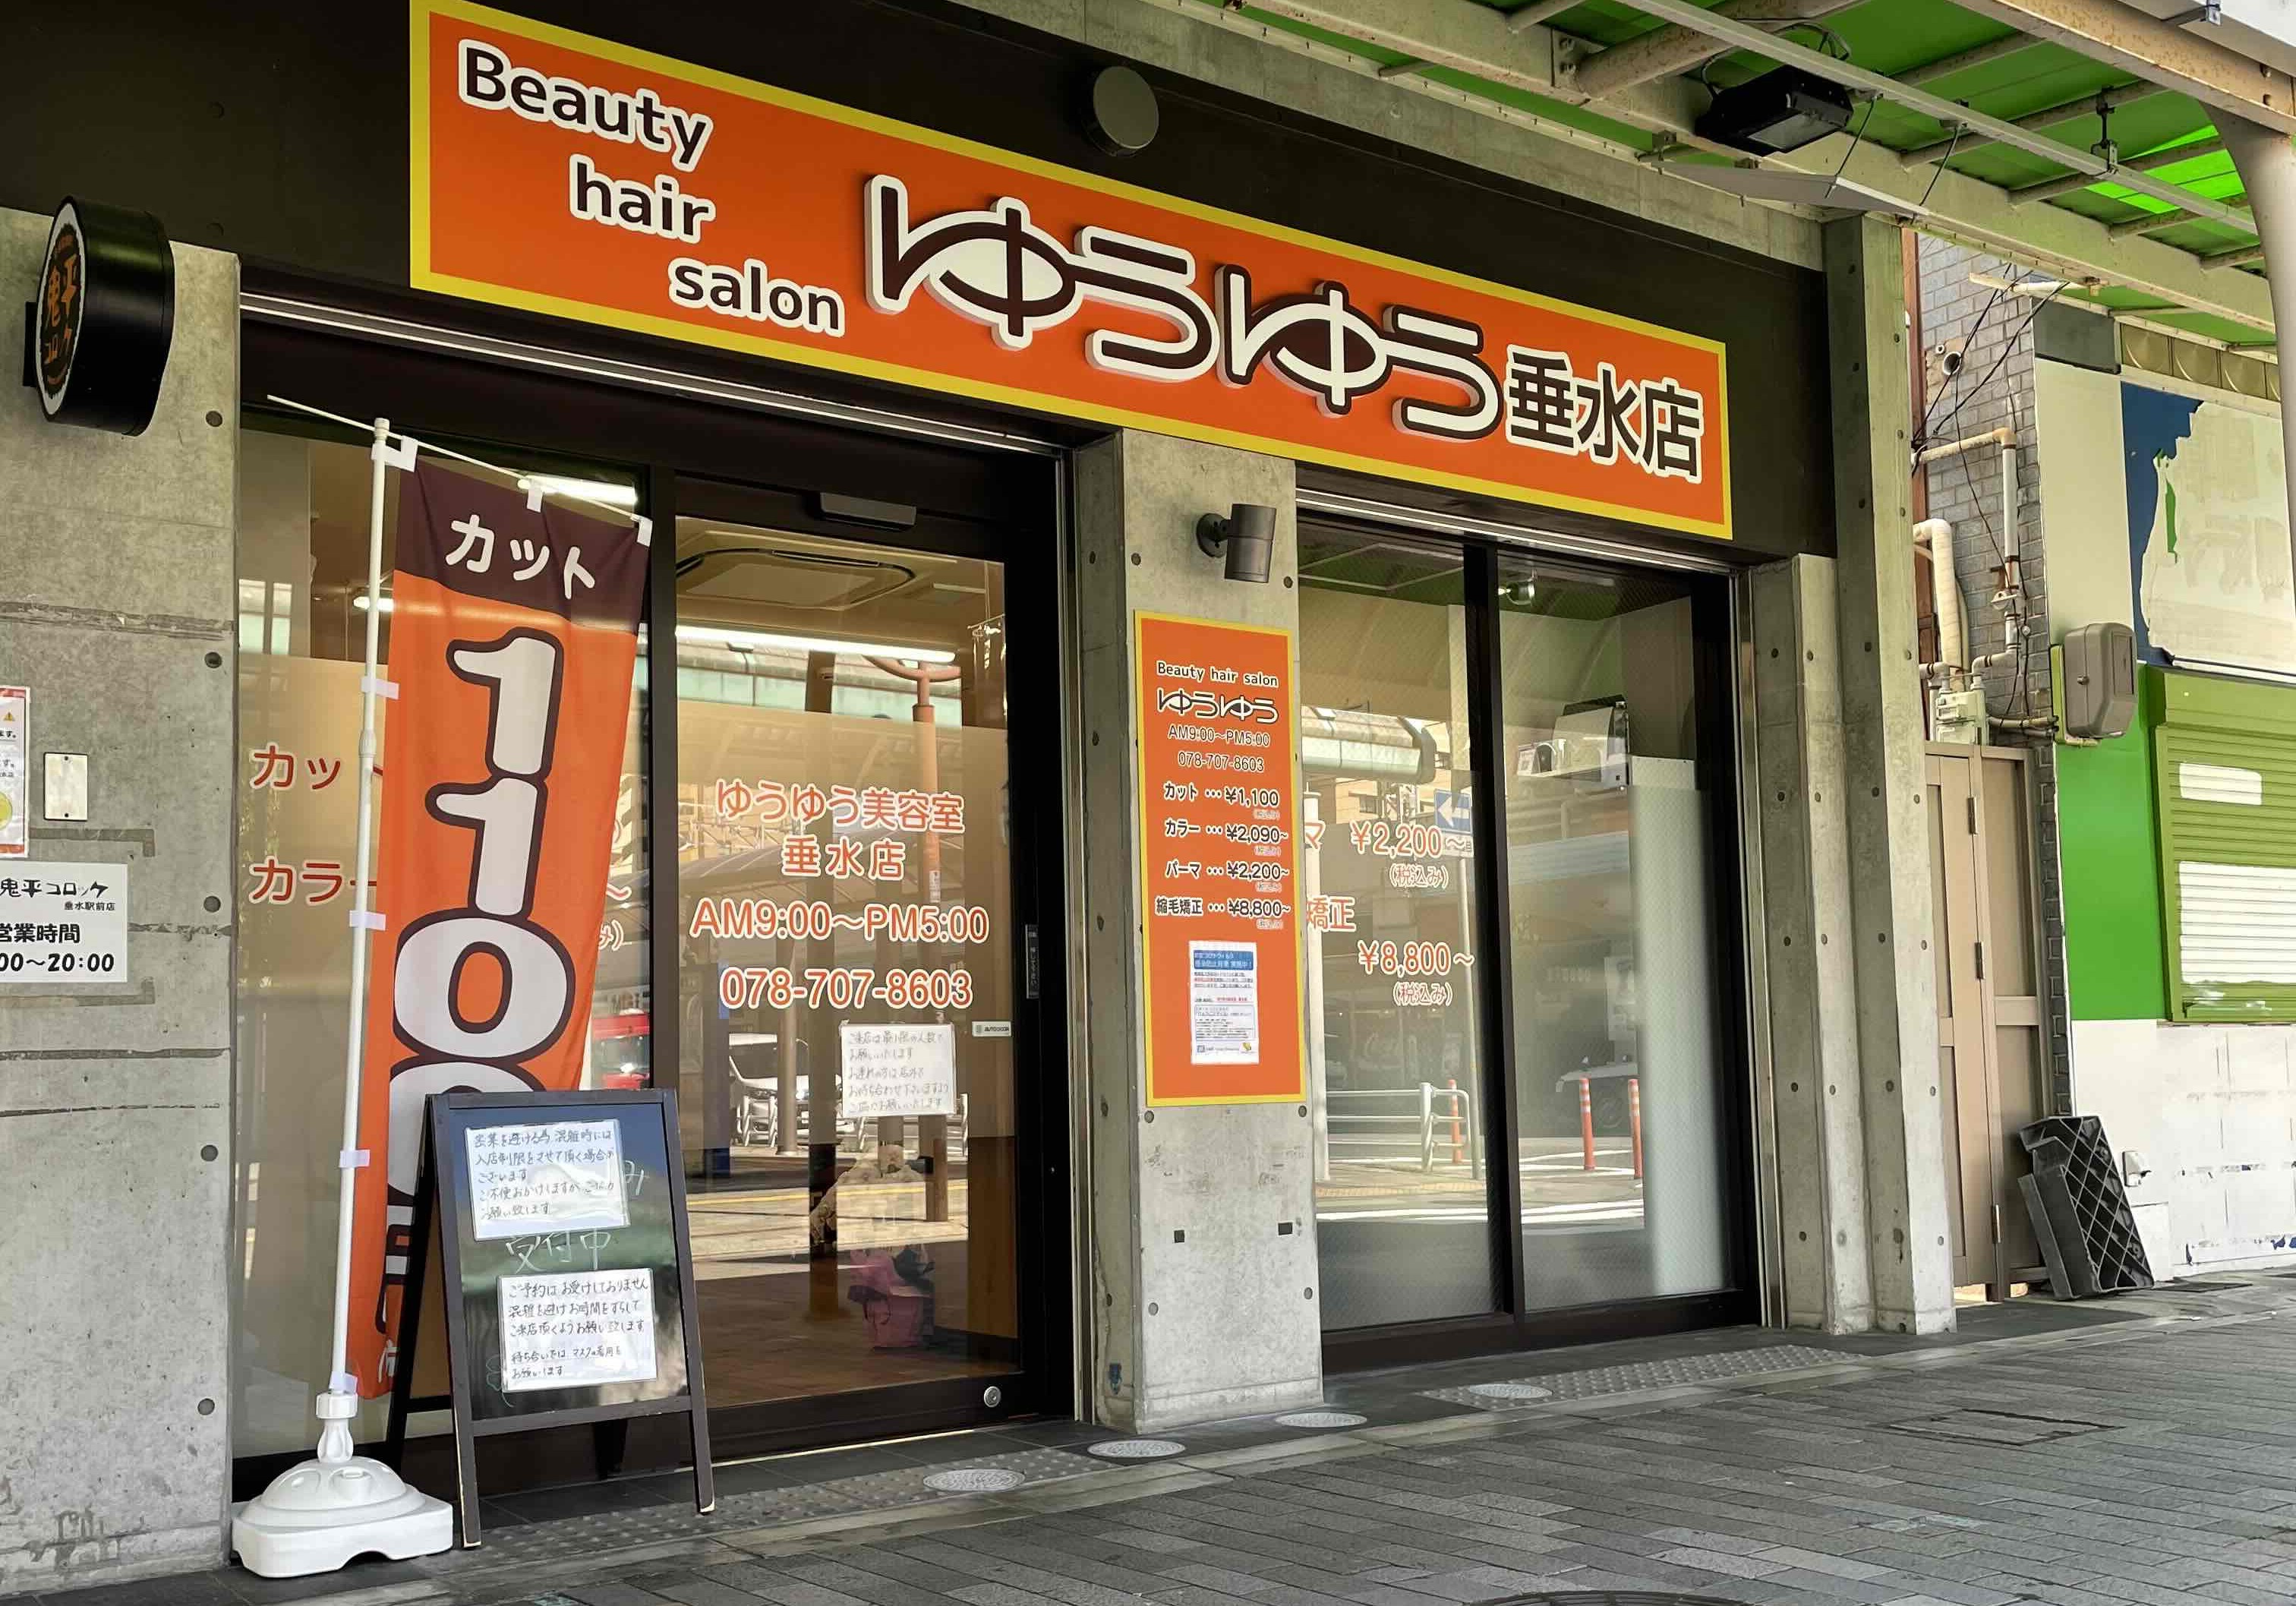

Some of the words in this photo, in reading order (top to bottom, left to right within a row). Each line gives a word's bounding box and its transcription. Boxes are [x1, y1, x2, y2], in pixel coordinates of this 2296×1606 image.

[459, 39, 714, 171] Beauty
[569, 153, 716, 243] hair
[668, 257, 845, 337] salon
[864, 175, 1502, 442] ゆうゆう
[1504, 343, 1705, 484] 垂水店
[445, 514, 595, 600] カット
[1156, 661, 1205, 683] Beauty
[1210, 666, 1238, 683] hair
[1244, 672, 1279, 687] salon
[1156, 688, 1279, 724] ゆうゆう
[249, 741, 383, 791] カッ
[1178, 750, 1265, 773] 078-707-8603
[717, 778, 966, 834] ゆうゆう美容室
[1164, 781, 1198, 801] カット
[1225, 787, 1279, 807] ¥1,100
[1165, 819, 1200, 838] カラー
[781, 834, 906, 881] 垂水店
[1165, 860, 1201, 879] パーマ
[0, 878, 109, 898] 鬼平コロッケ
[0, 922, 81, 944] 営業時間
[719, 967, 973, 1009] 078-707-8603
